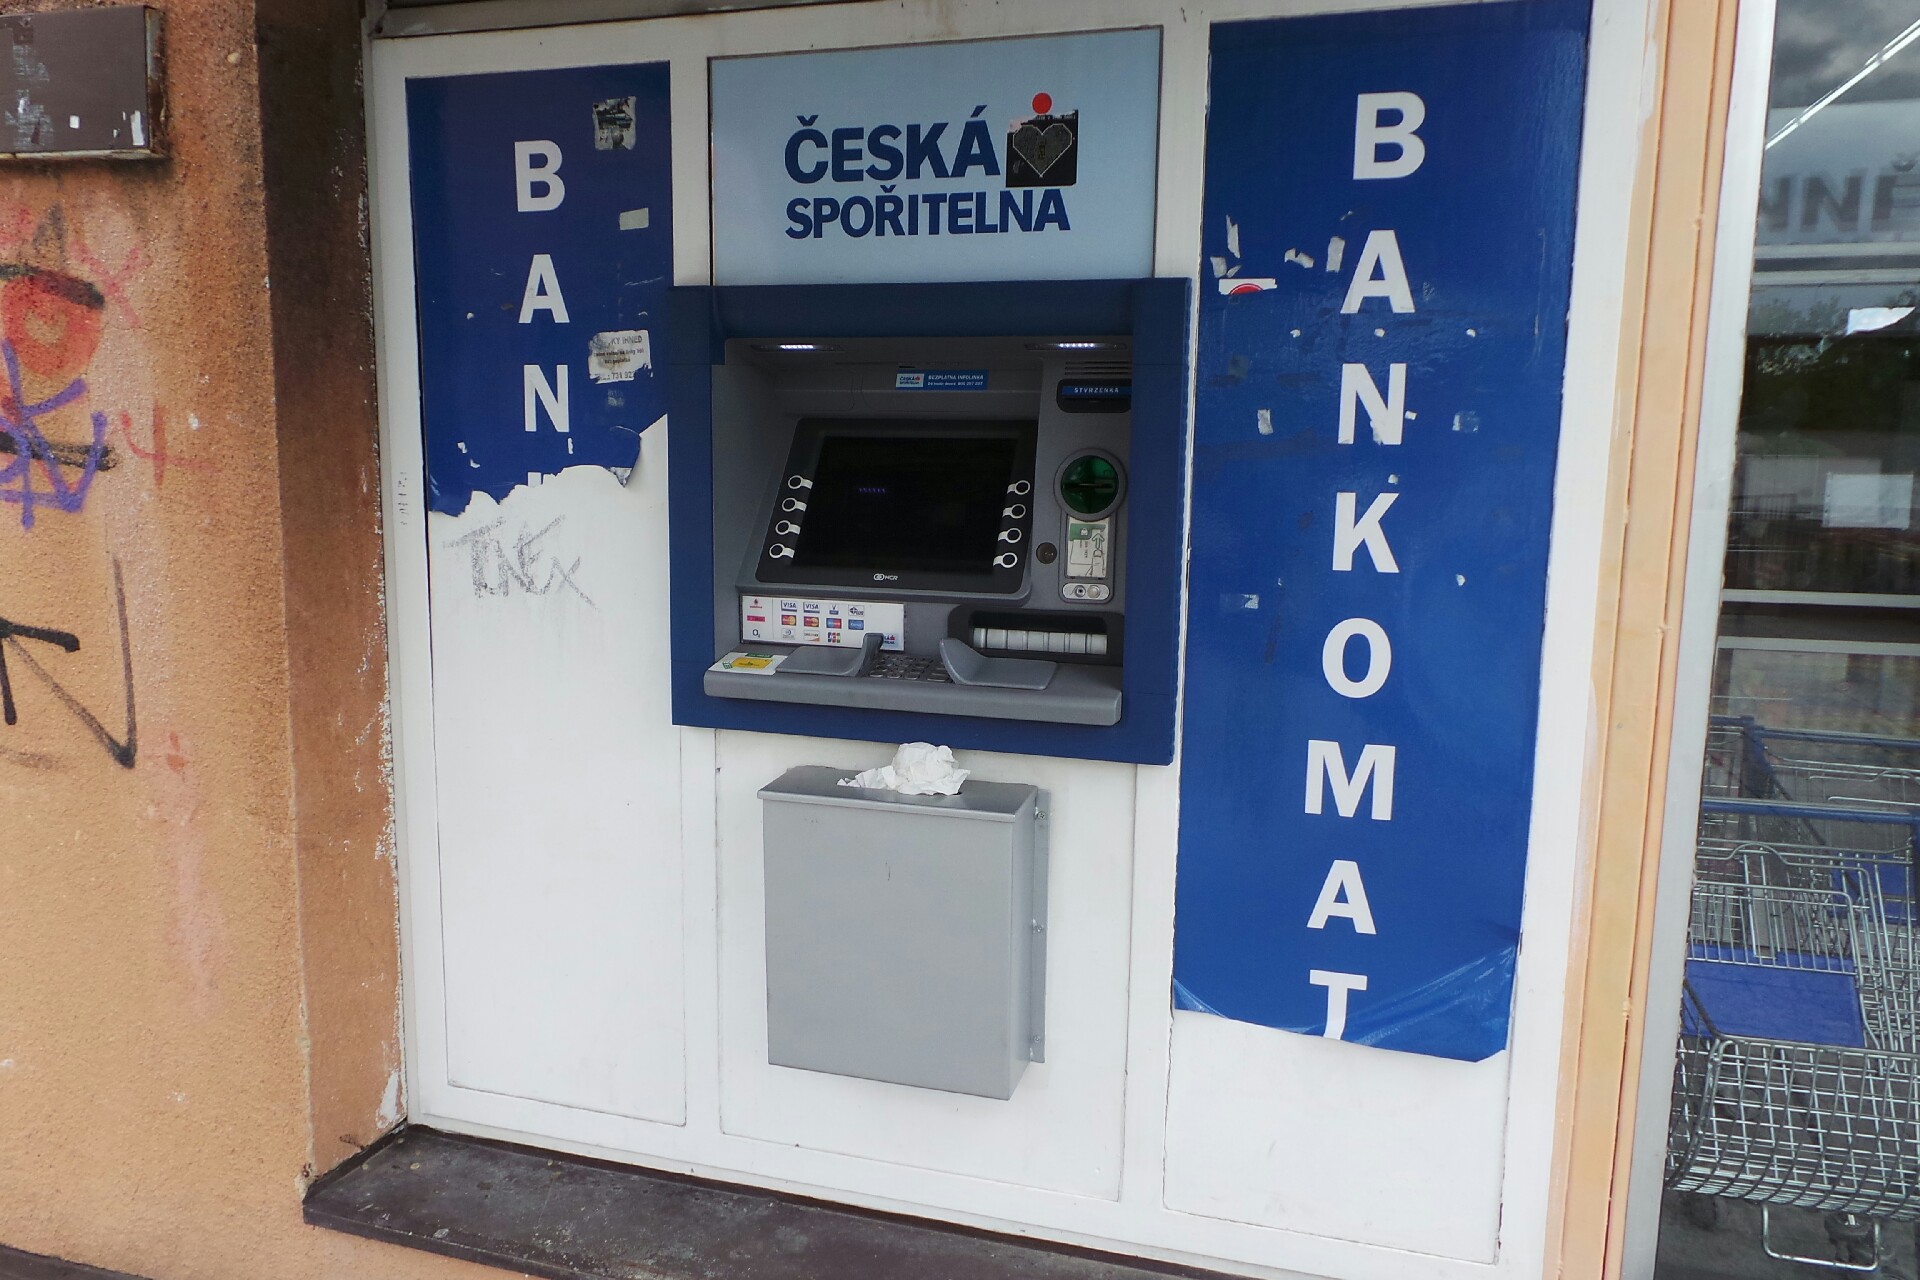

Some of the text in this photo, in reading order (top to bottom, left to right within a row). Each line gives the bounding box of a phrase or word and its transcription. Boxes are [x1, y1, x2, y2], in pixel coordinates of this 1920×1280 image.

[784, 104, 1000, 184] ČESKÁ
[785, 184, 1071, 240] SPOŘITELNA
[1304, 91, 1426, 1041] BANKOMAT
